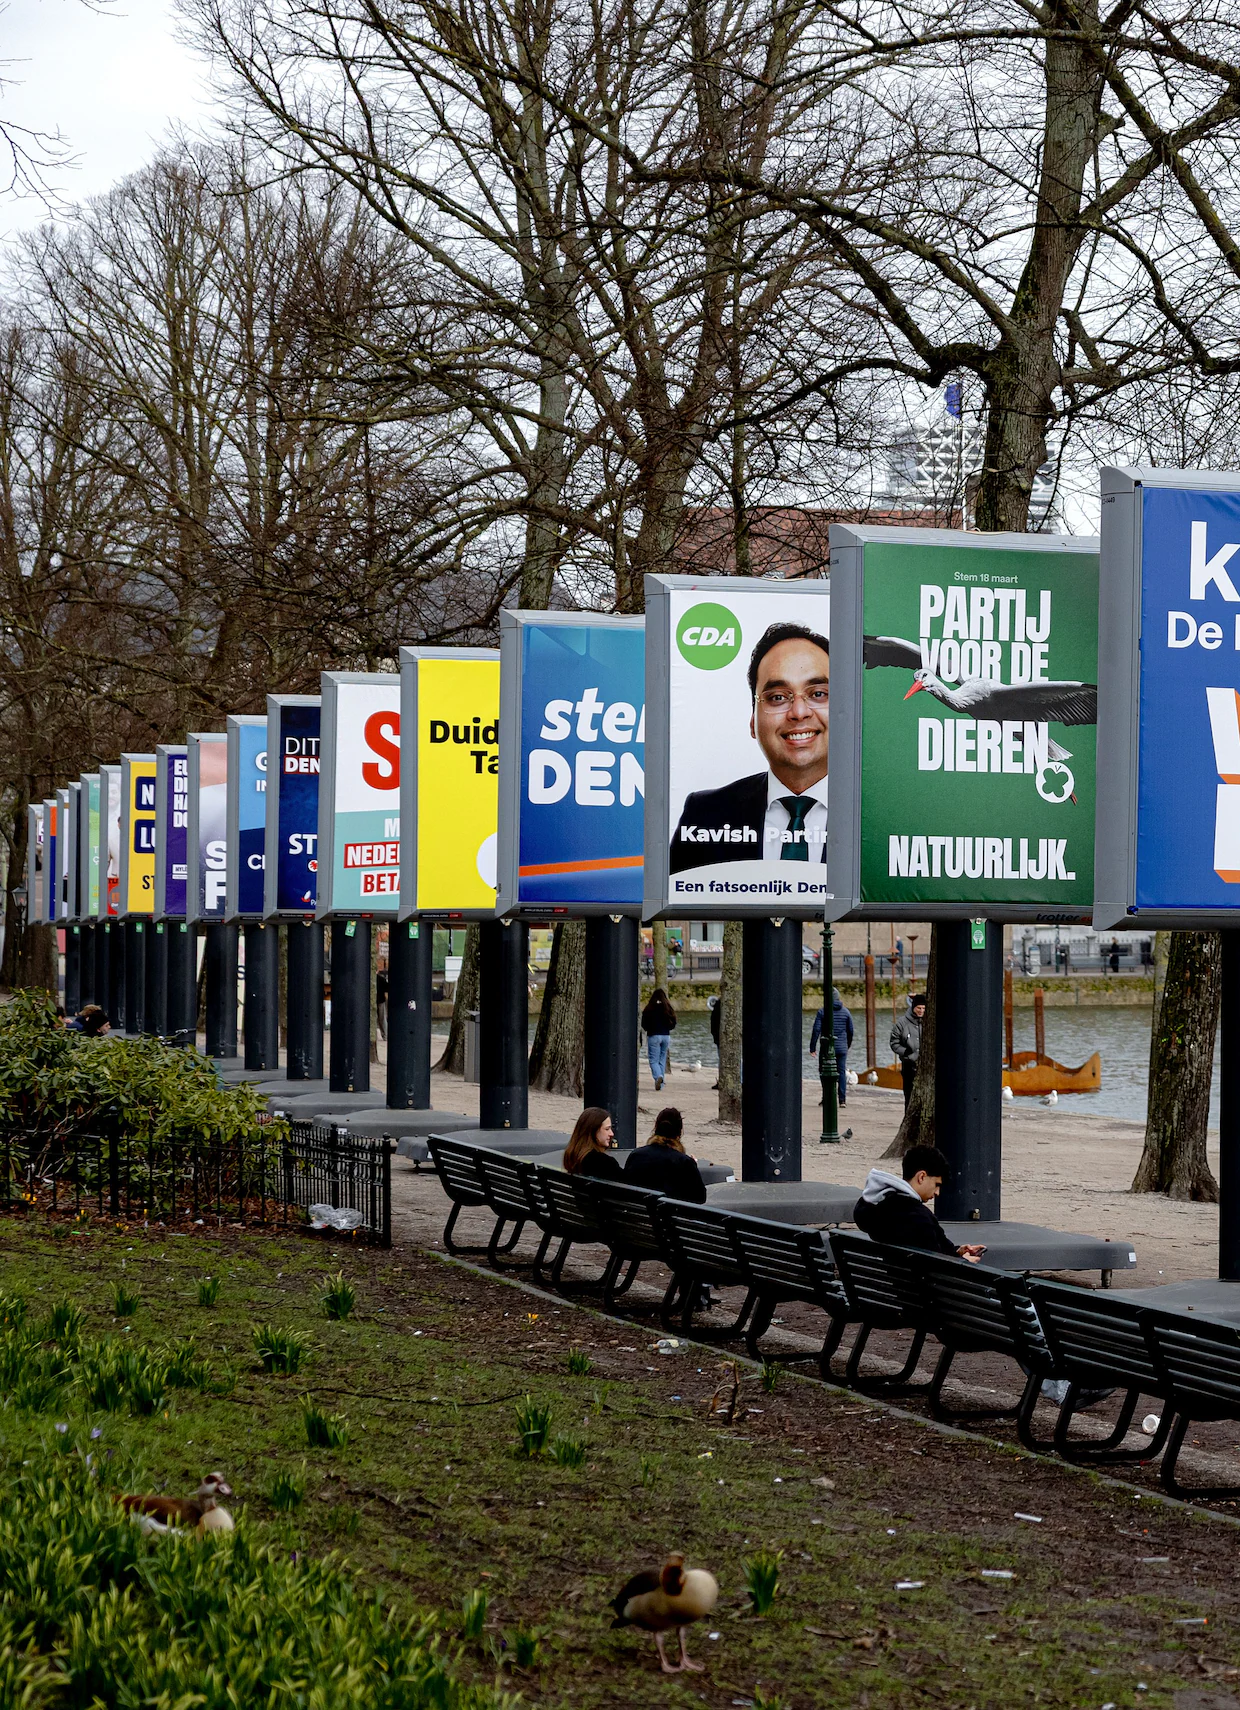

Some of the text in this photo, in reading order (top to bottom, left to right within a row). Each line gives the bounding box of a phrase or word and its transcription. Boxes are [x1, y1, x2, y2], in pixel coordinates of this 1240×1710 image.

[954, 571, 1018, 584] Stem 18 maart
[920, 584, 1051, 642] PARTIJ
[682, 626, 735, 647] CDA
[1168, 611, 1223, 651] De
[920, 637, 1049, 685] VOOR DE
[285, 736, 320, 755] DIT
[918, 717, 1049, 774] DIEREN
[289, 833, 318, 855] ST
[680, 824, 757, 843] Kavish
[347, 843, 400, 866] NEDE
[888, 835, 1076, 881] NATUURLIJK.
[363, 872, 400, 893] BET
[675, 880, 827, 896] Een fatsoenlijk Den
